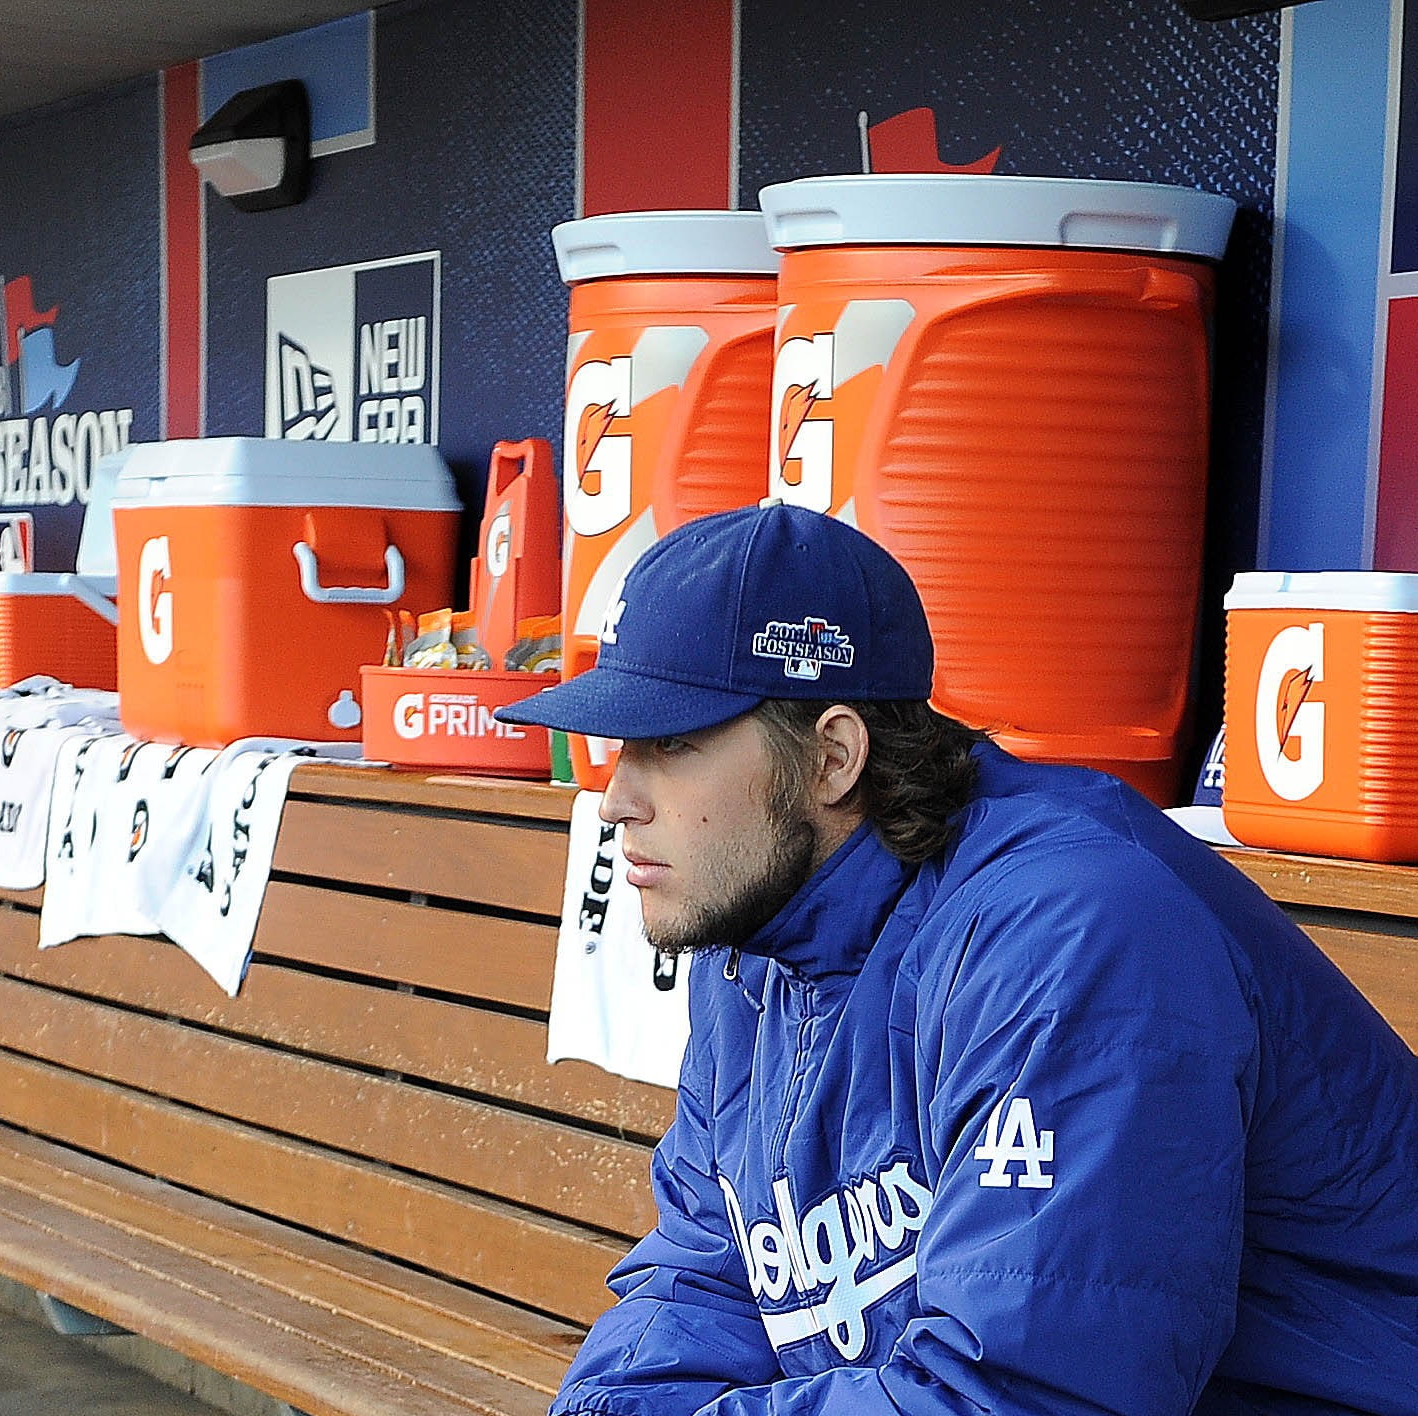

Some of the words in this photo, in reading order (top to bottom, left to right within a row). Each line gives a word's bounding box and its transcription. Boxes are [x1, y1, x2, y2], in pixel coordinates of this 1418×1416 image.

[359, 316, 427, 396] NEW
[564, 355, 634, 537] G
[772, 332, 836, 516] G
[138, 536, 174, 665] G
[756, 636, 852, 663] POSTSEASON
[1255, 622, 1326, 801] G
[974, 1083, 1055, 1188] LA
